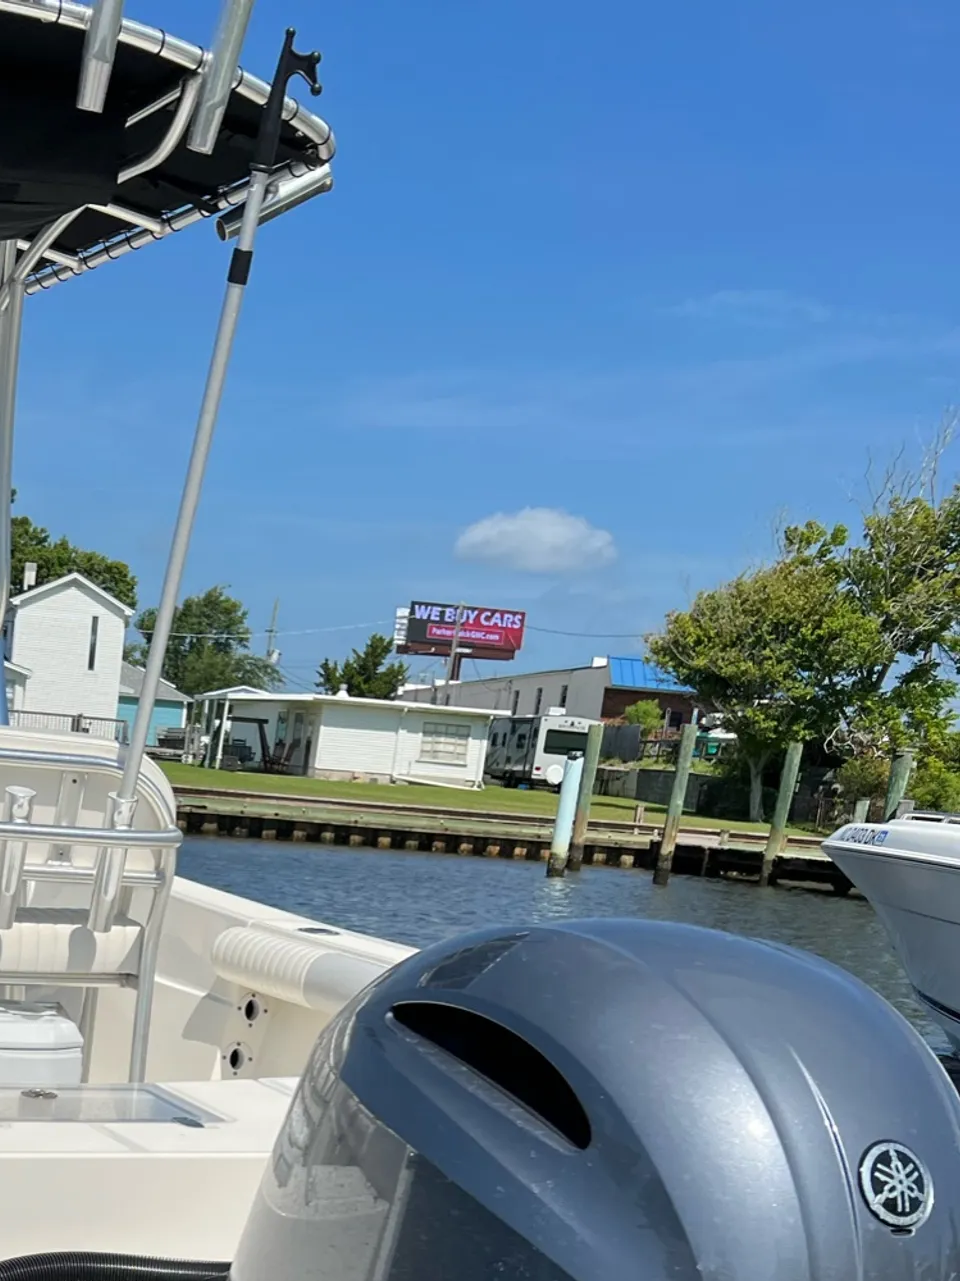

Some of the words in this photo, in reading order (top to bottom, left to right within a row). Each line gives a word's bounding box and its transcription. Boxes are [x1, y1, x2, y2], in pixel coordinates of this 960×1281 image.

[415, 605, 440, 620] WE
[444, 608, 478, 624] BUY
[480, 611, 522, 629] CARS
